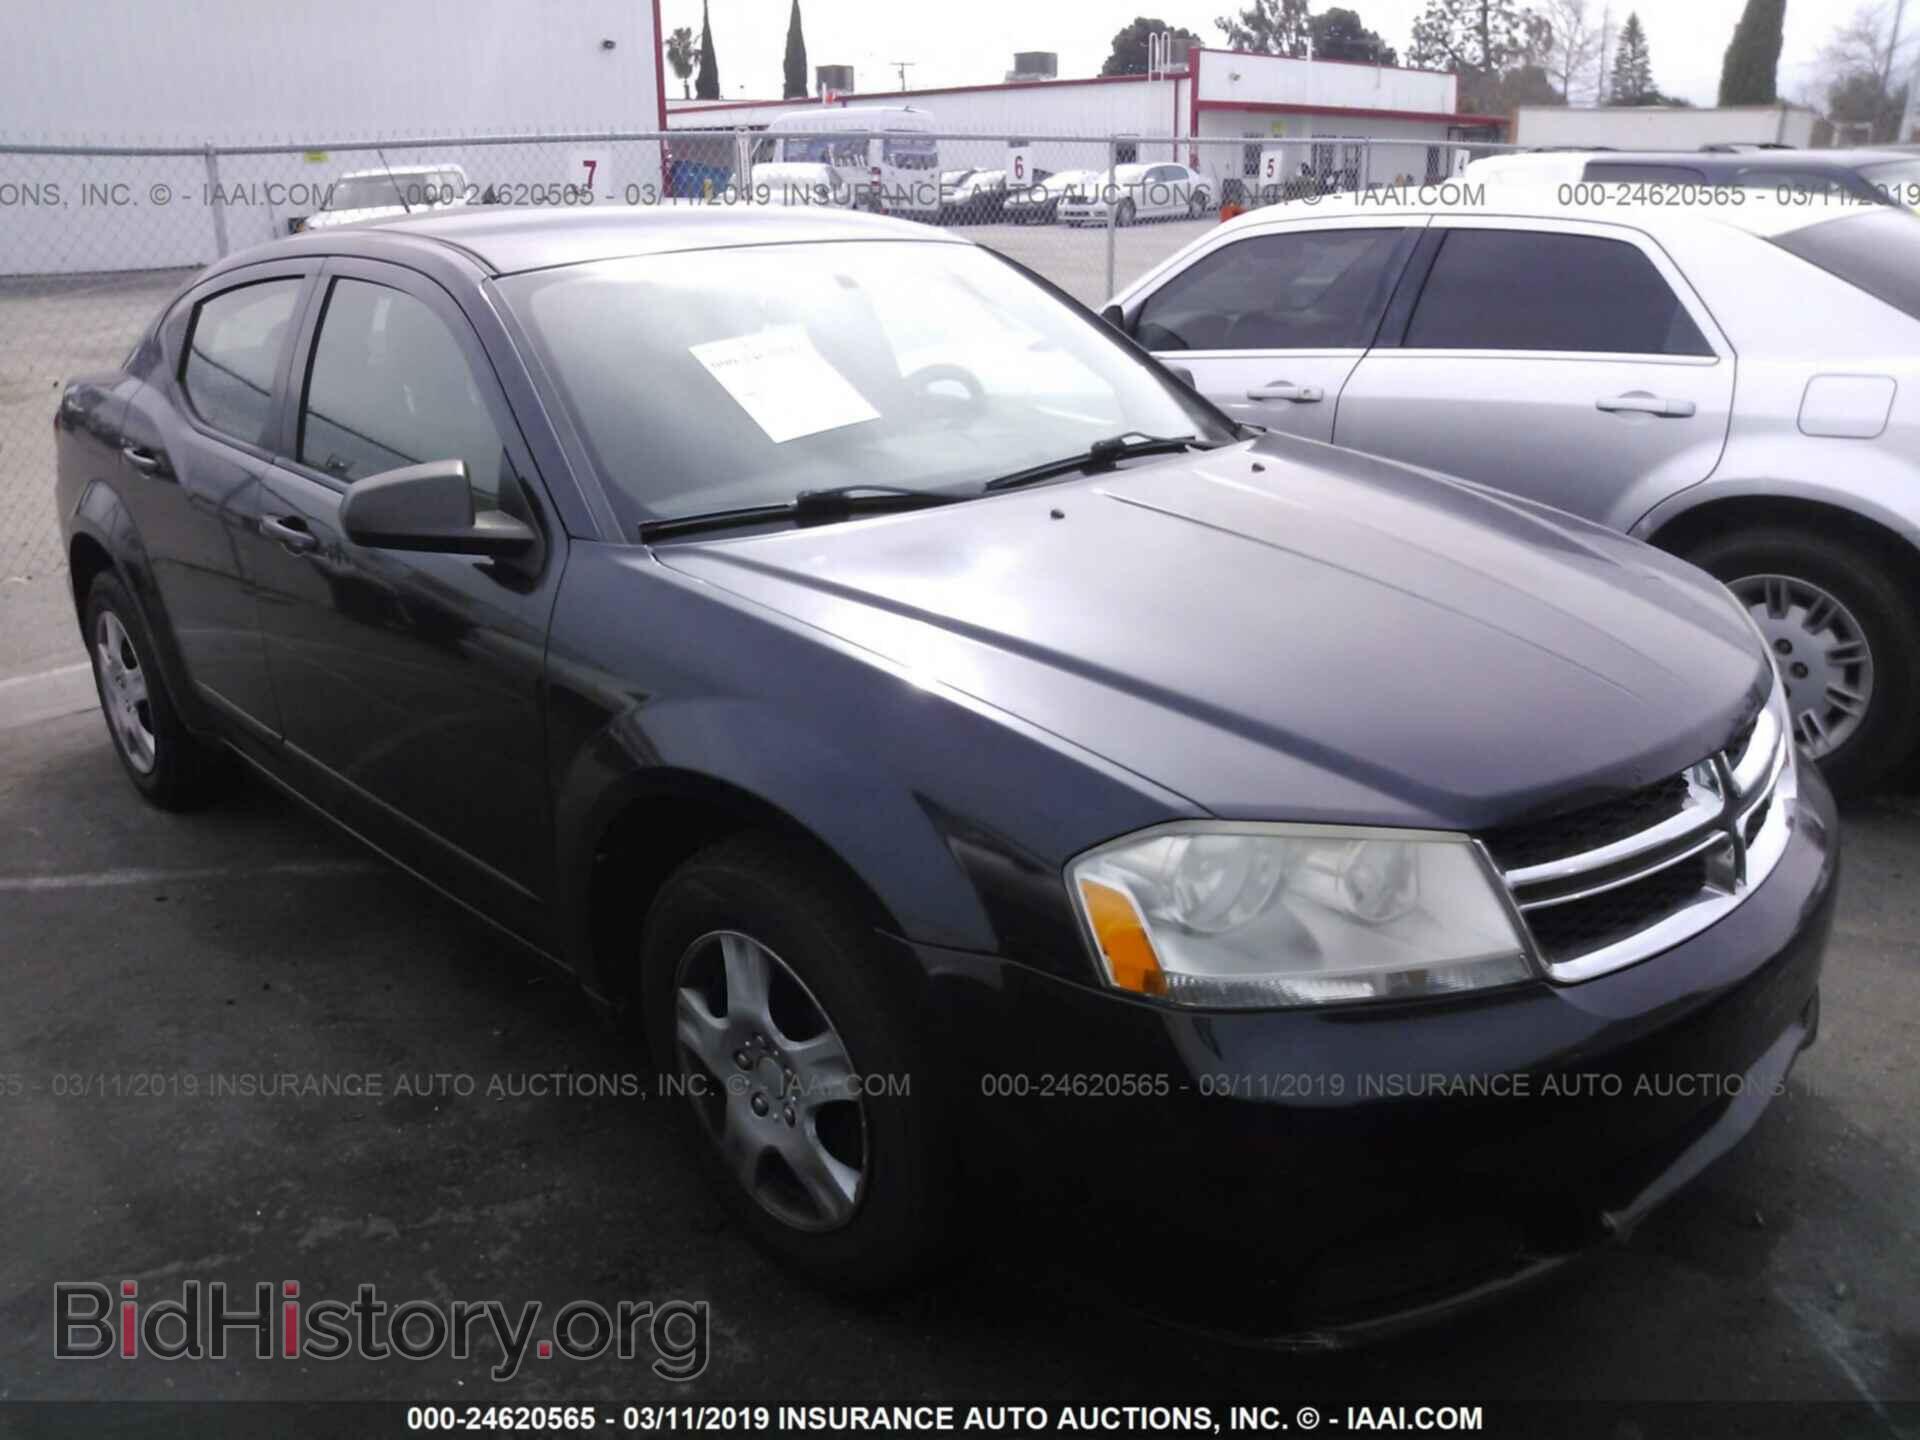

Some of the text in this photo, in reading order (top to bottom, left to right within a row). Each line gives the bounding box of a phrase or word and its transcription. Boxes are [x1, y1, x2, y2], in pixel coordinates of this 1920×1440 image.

[582, 160, 598, 190] 7
[1012, 154, 1025, 179] 6
[1266, 158, 1275, 178] 5
